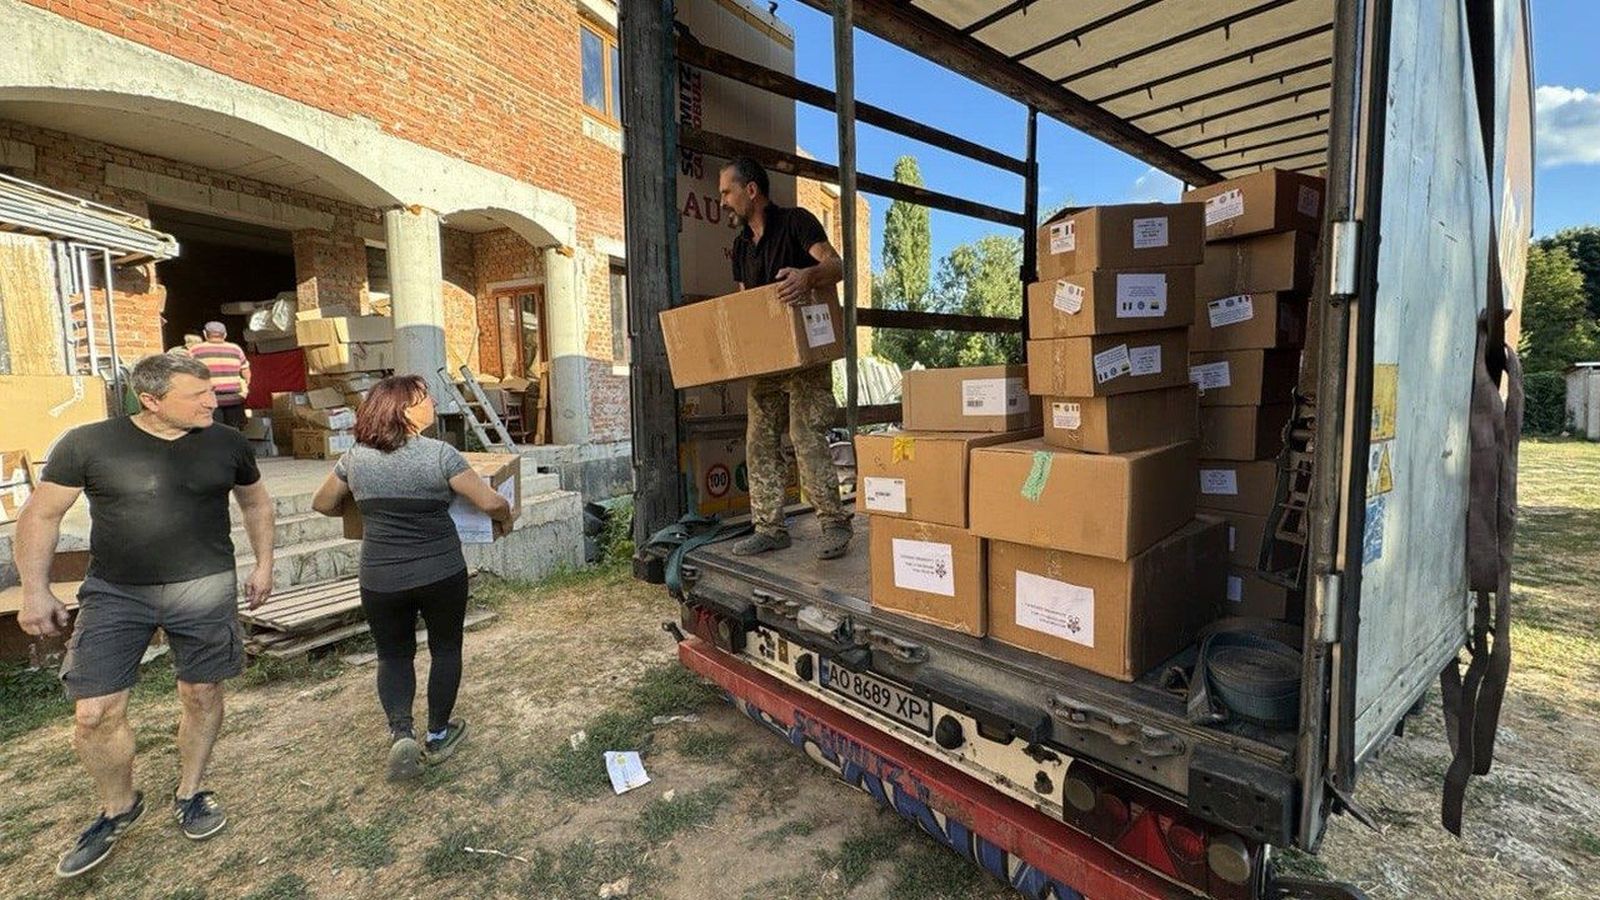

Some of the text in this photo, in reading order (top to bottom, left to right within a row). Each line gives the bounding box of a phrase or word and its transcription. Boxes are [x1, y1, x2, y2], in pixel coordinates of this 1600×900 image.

[679, 62, 693, 177] SCMITZ
[830, 664, 850, 689] AO
[853, 677, 891, 708] 8689
[896, 692, 922, 719] XP
